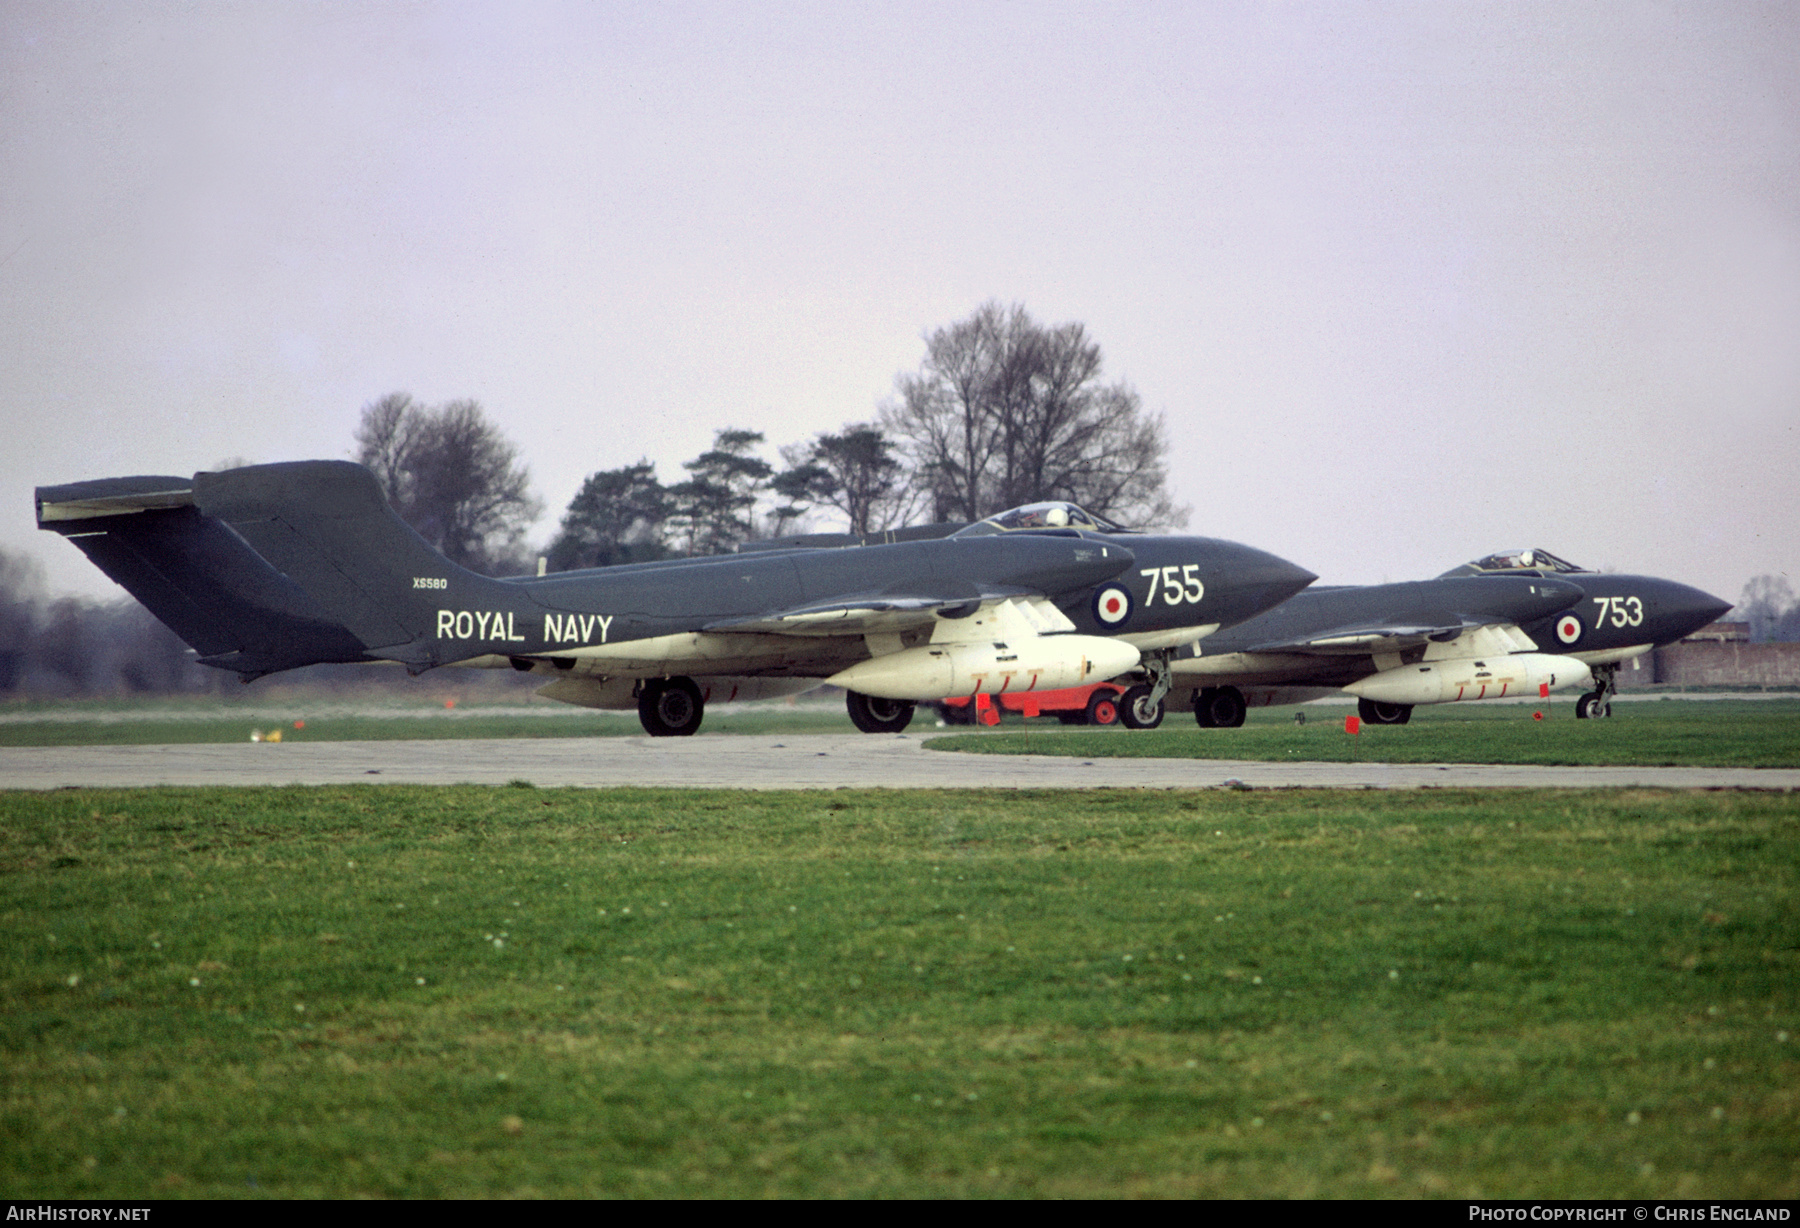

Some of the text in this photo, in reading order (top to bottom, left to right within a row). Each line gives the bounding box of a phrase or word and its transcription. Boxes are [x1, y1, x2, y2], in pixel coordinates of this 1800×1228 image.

[413, 577, 447, 589] XS580
[1140, 564, 1204, 607] 755
[437, 610, 613, 643] ROYAL NAVY
[1593, 596, 1644, 629] 753
